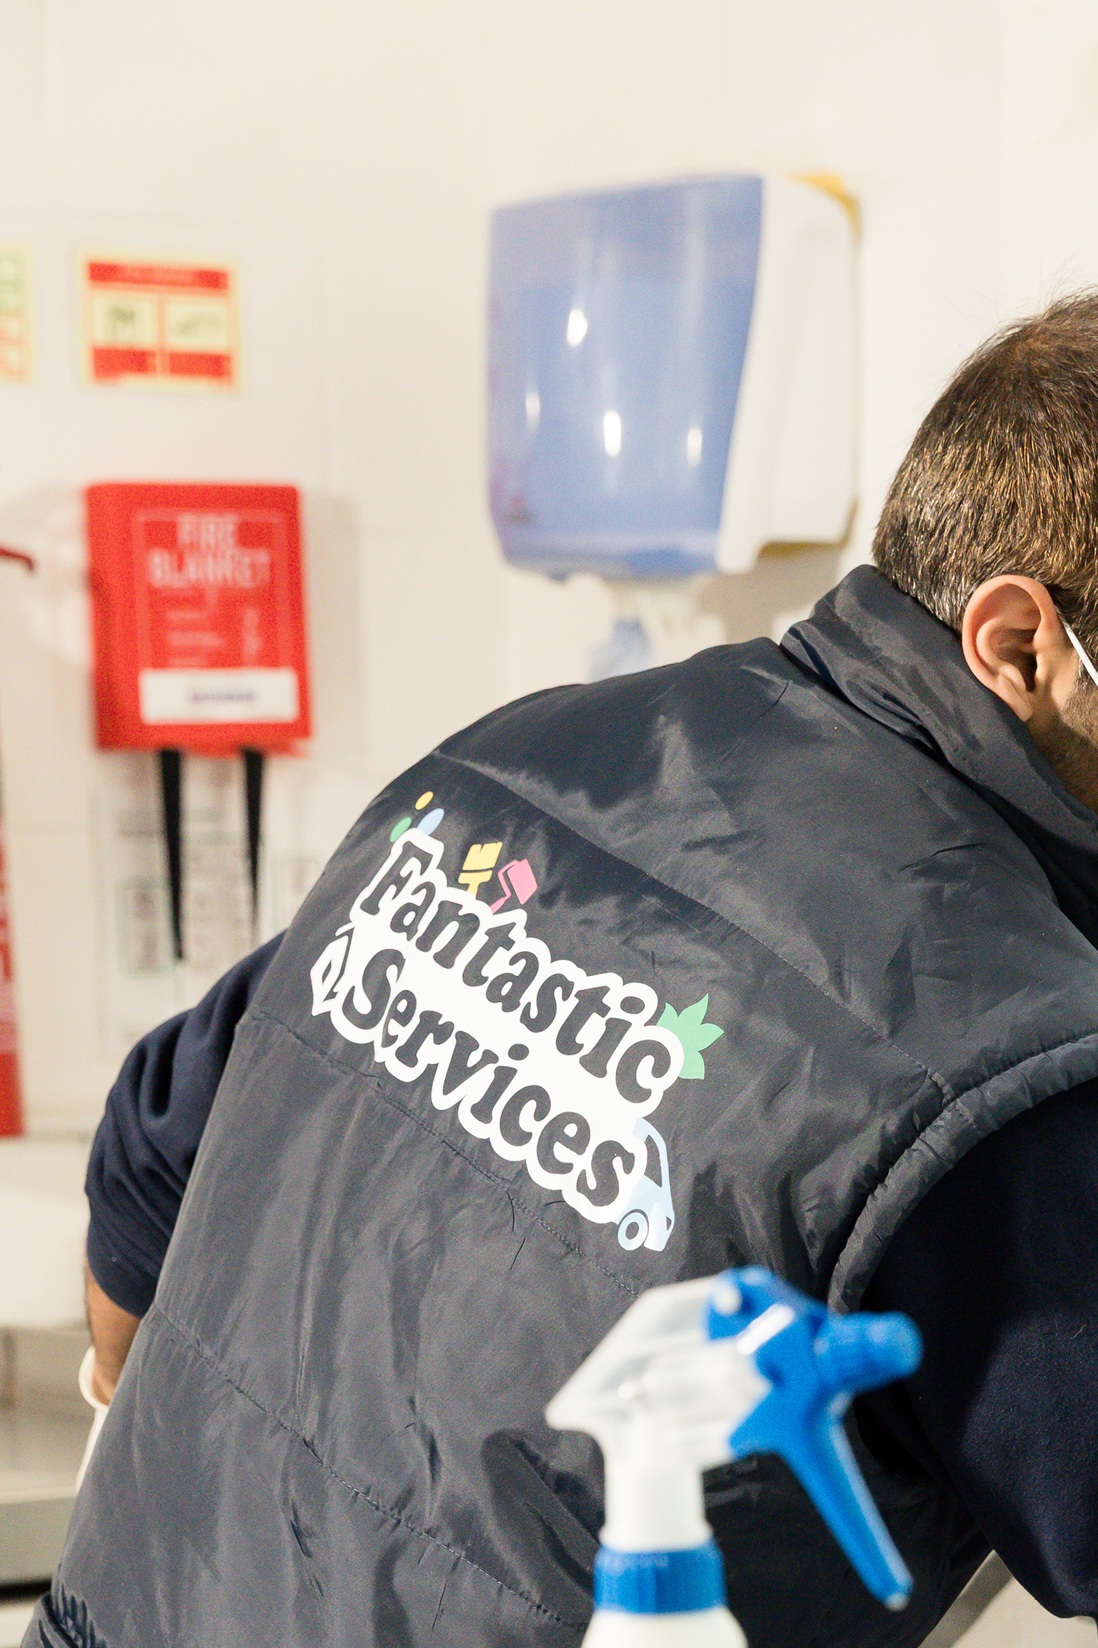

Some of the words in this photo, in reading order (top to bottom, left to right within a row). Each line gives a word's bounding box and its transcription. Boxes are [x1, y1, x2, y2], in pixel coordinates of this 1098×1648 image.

[147, 549, 270, 589] BLANKET
[177, 513, 237, 549] FIRE
[361, 840, 672, 1103] Fantastic
[341, 948, 636, 1207] Services
